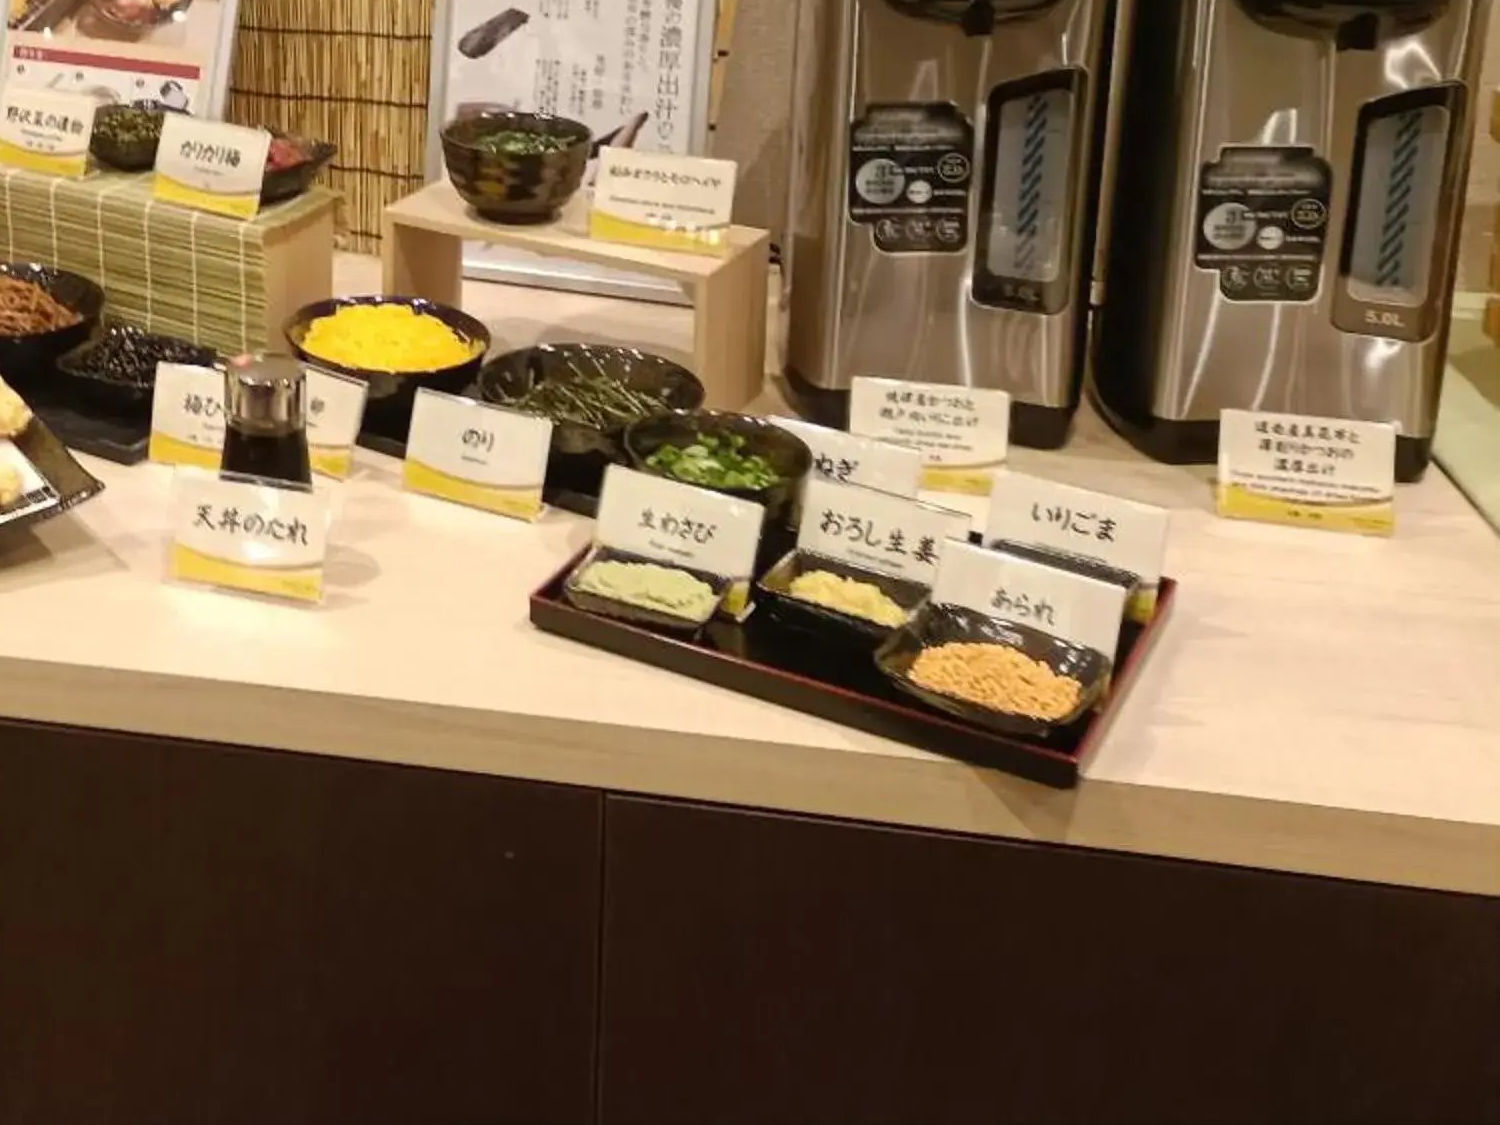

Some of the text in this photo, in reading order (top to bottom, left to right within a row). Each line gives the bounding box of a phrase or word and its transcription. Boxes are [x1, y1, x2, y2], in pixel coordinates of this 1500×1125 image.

[461, 428, 496, 453] のり
[813, 452, 860, 483] ねぎ
[192, 504, 309, 547] 天丼のたれ
[638, 508, 718, 545] 生わさび
[819, 508, 942, 565] おろし生姜
[1031, 502, 1118, 544] いりごま
[990, 587, 1057, 626] あられ
